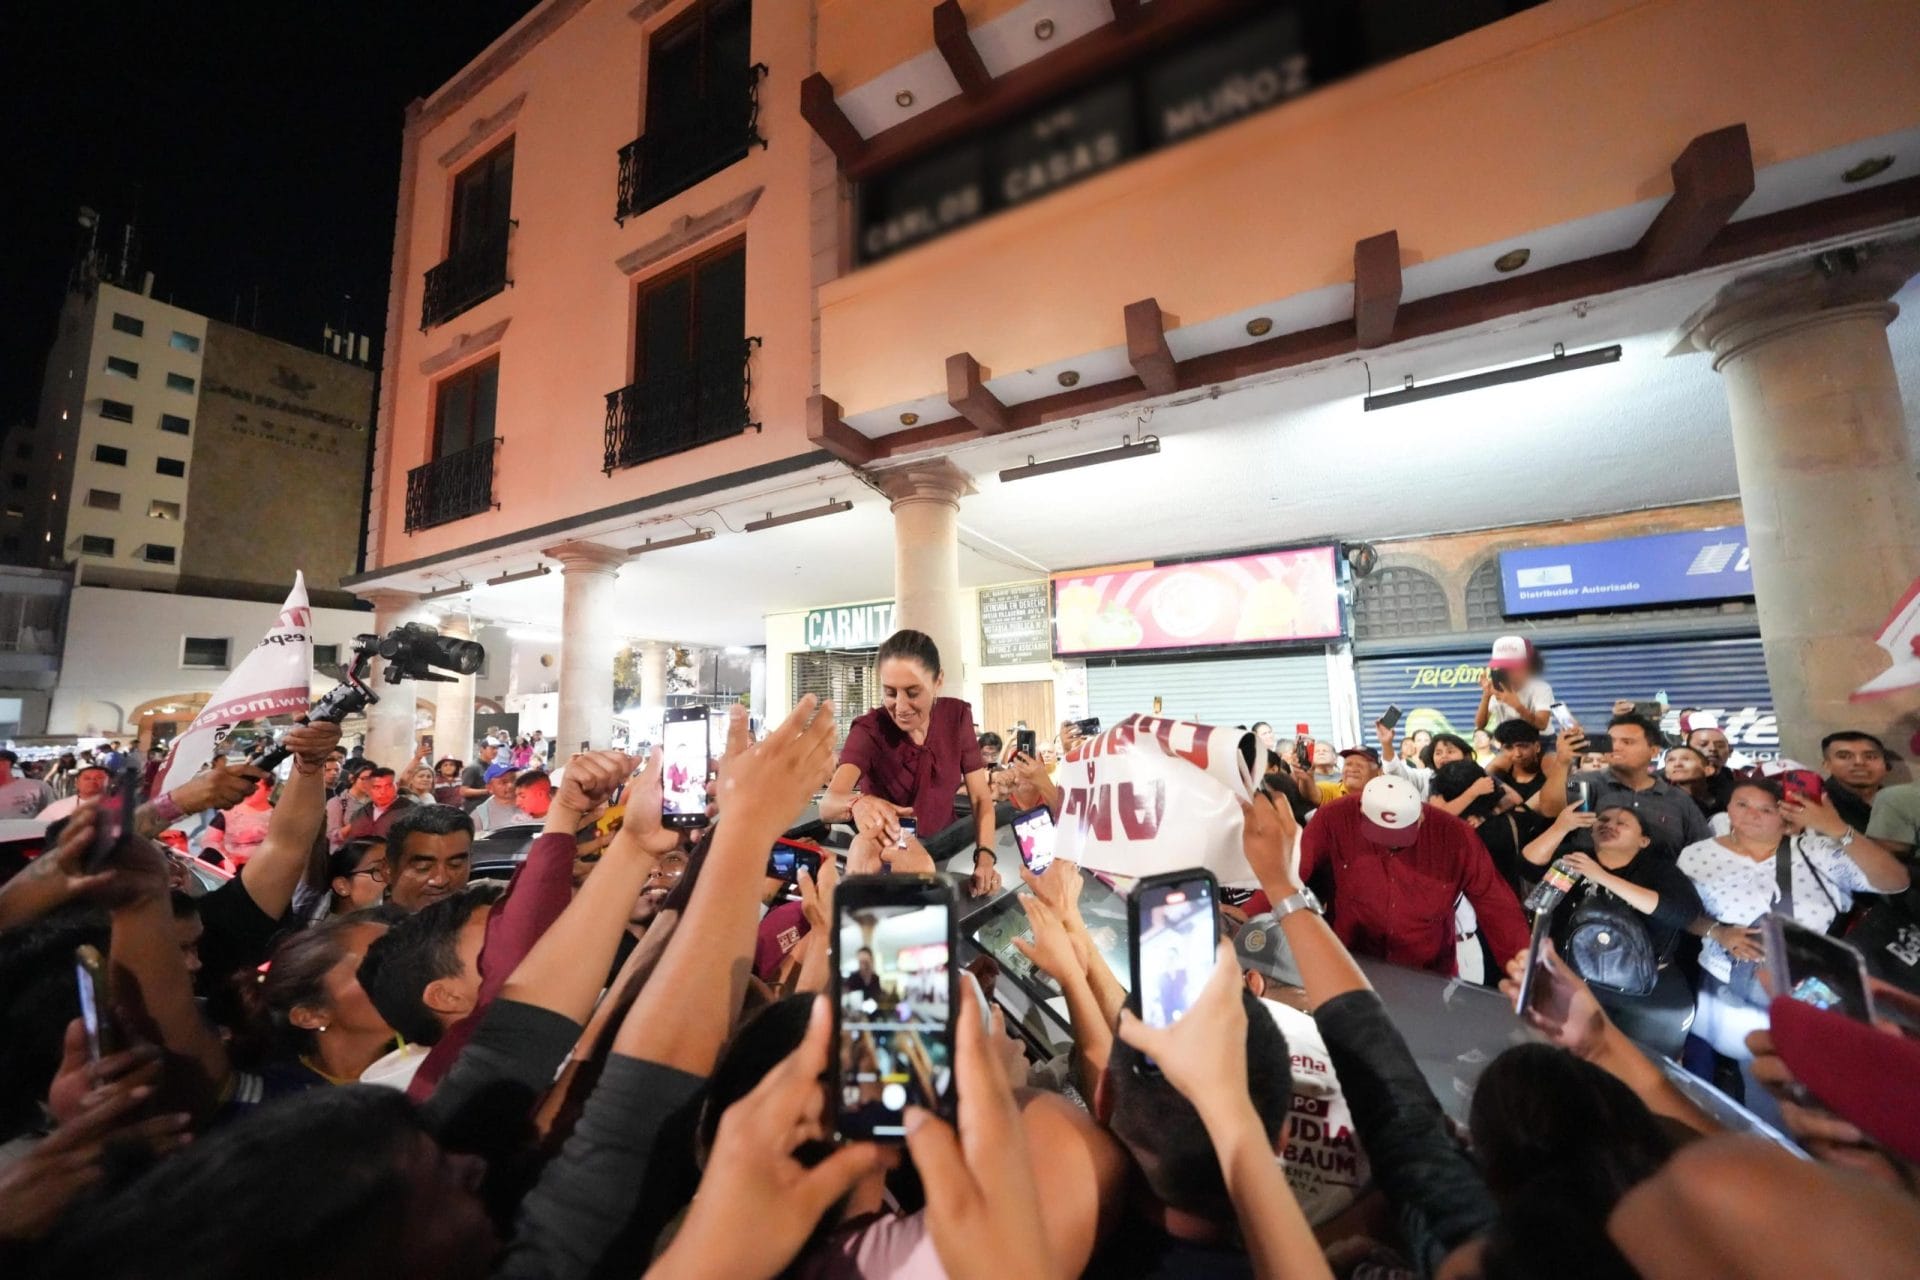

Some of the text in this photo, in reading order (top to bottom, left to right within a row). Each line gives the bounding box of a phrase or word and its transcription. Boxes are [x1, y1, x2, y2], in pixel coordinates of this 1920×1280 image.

[1004, 134, 1119, 199] CASAS
[1162, 56, 1309, 136] MUÑOZ
[1519, 581, 1640, 600] Distribuidor Autorizado
[1283, 1144, 1358, 1178] BAUM
